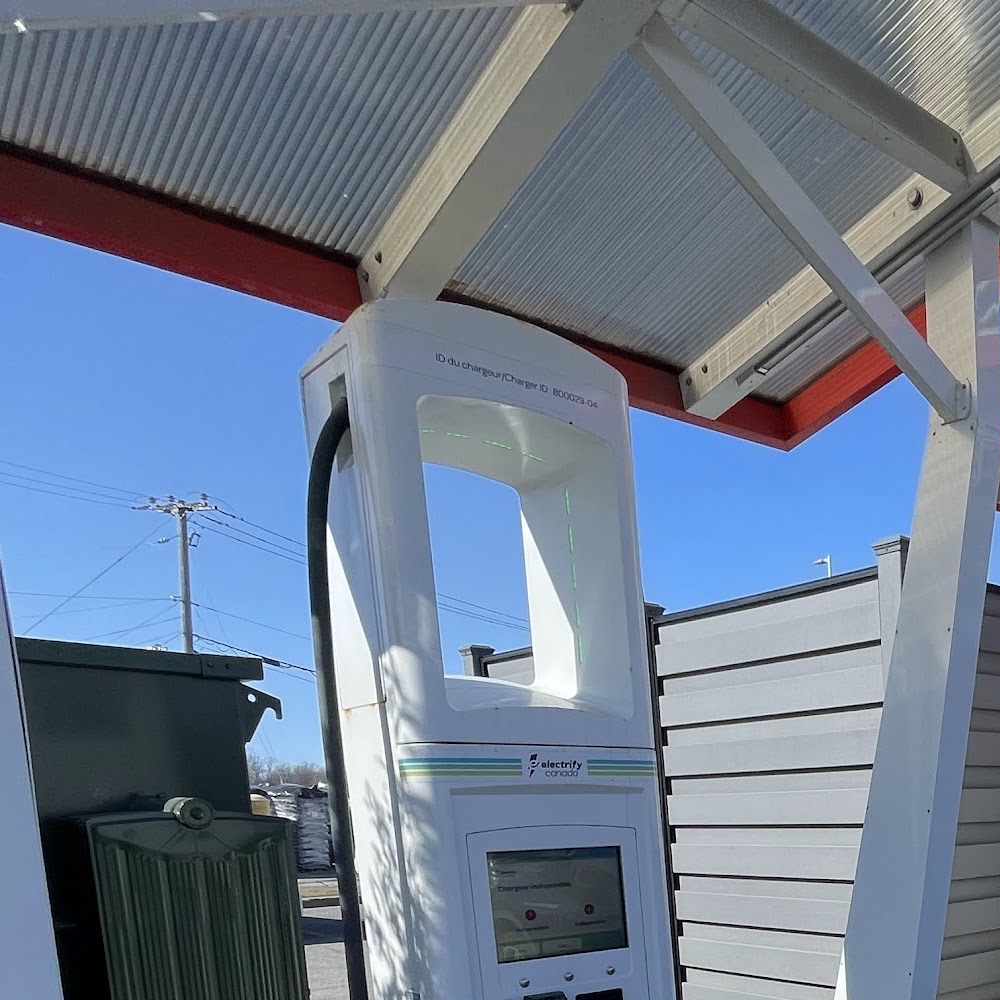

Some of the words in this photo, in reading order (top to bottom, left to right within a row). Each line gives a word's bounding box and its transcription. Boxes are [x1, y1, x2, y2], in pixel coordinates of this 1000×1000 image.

[435, 353, 446, 363] ID
[447, 357, 460, 368] du
[539, 384, 549, 393] ID
[541, 760, 583, 771] electrify
[544, 769, 579, 778] canada
